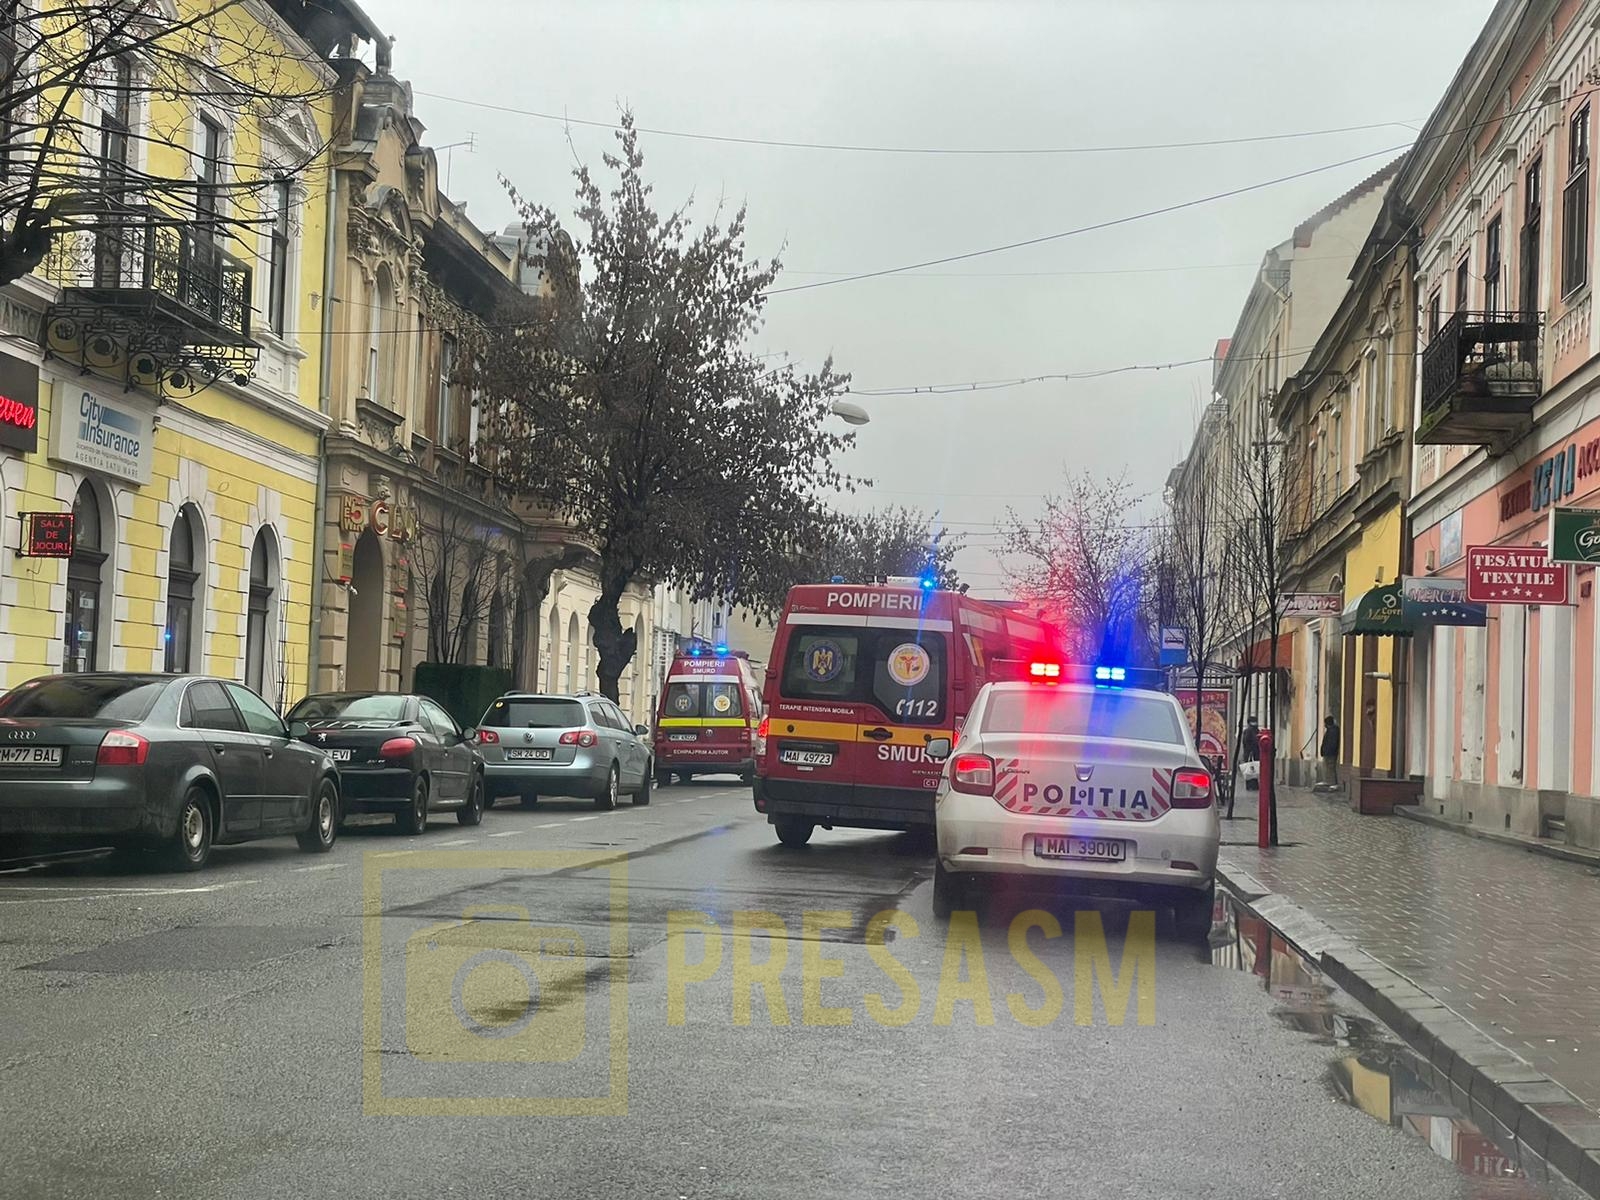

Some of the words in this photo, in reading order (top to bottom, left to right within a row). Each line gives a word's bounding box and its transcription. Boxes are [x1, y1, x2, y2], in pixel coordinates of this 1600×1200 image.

[80, 392, 101, 428] City
[85, 424, 140, 458] Insurance
[40, 520, 65, 528] SALA
[45, 530, 58, 539] DE
[35, 541, 68, 550] JOCURI
[1479, 571, 1555, 585] TEXTILE
[827, 592, 923, 610] POMPIERII
[802, 705, 832, 713] INTENSIVA
[831, 707, 855, 715] MOBILA
[905, 699, 938, 717] 112
[0, 749, 11, 761] M
[14, 749, 31, 761] 77
[33, 749, 58, 762] BAL
[332, 750, 350, 760] EVI
[785, 751, 800, 762] MAI
[803, 752, 831, 764] 49723
[1047, 838, 1070, 854] MAI
[1078, 840, 1120, 857] 39010
